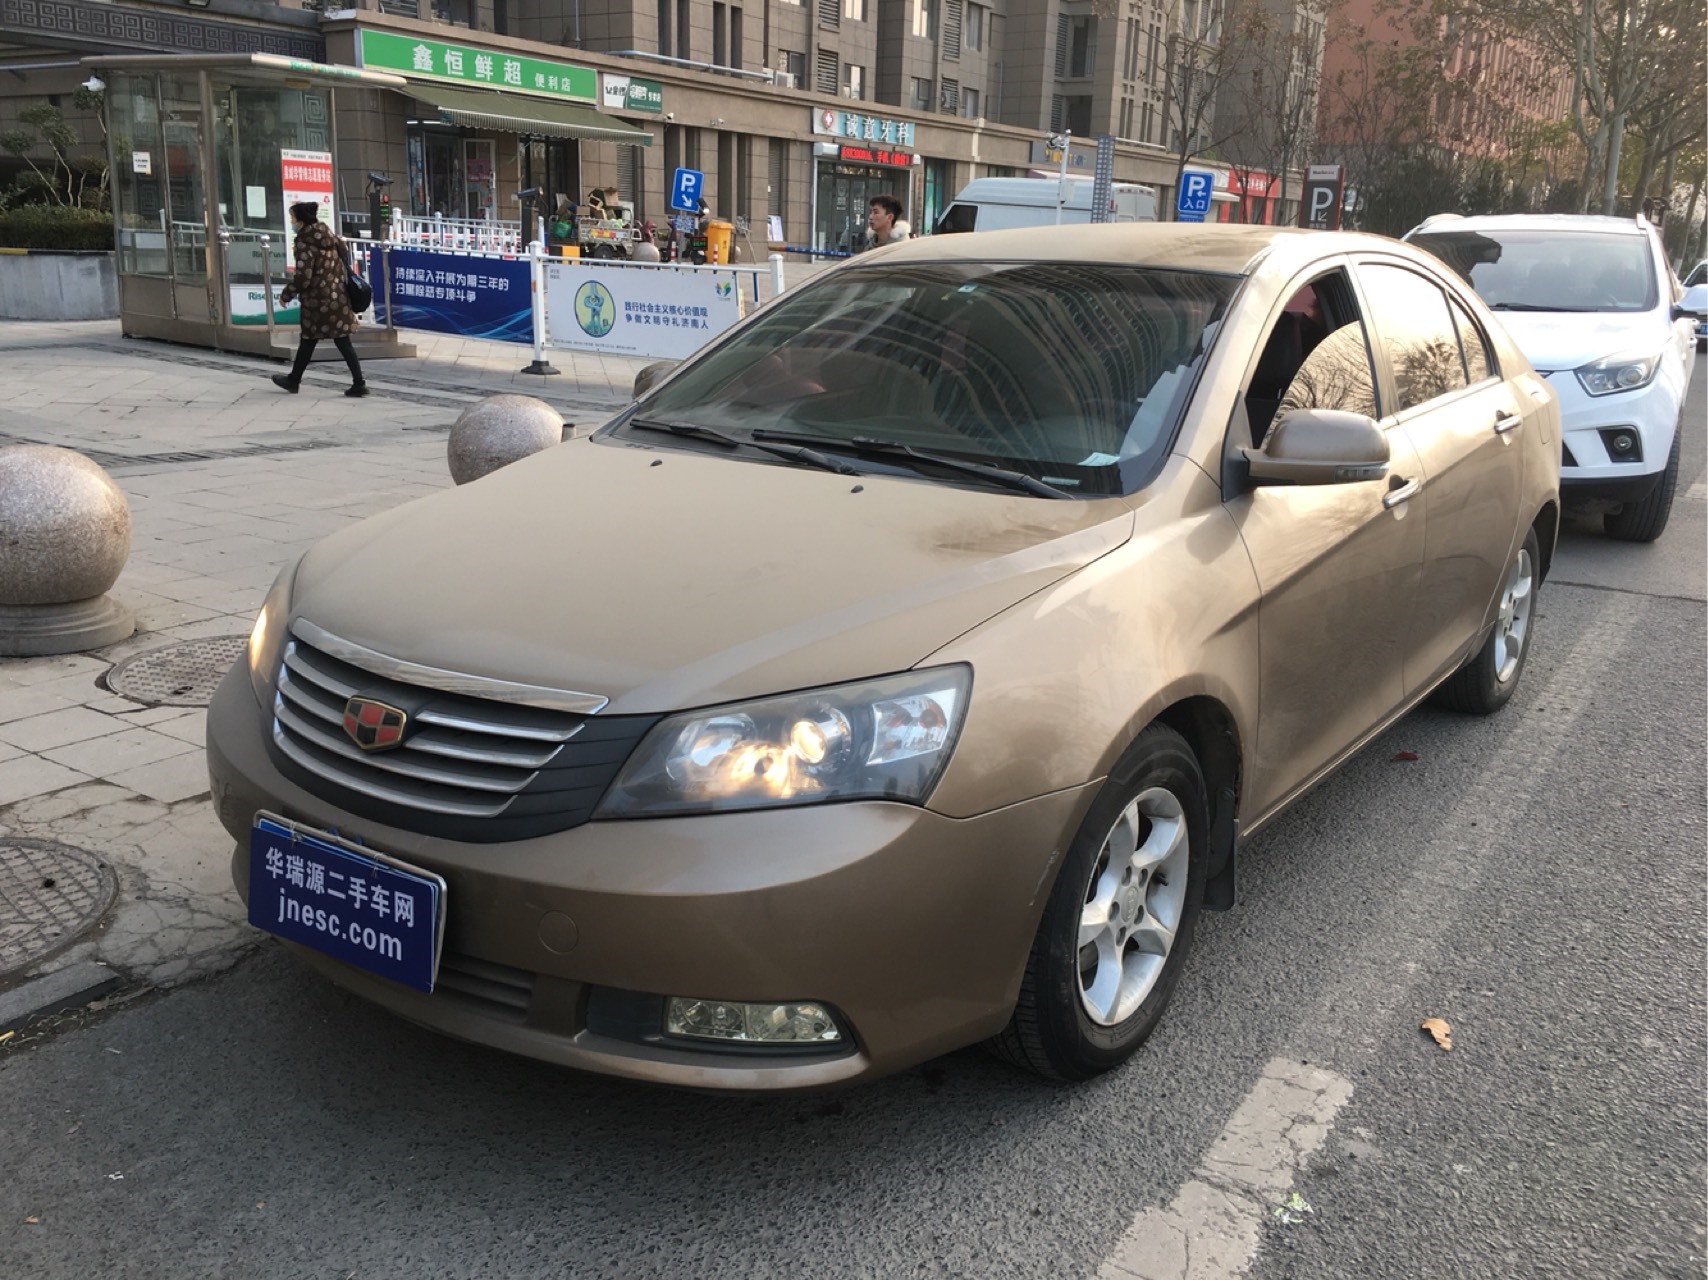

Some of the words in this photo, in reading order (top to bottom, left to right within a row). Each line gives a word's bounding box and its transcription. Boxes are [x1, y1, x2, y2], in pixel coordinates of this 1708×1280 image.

[412, 43, 522, 86] 鑫恒鲜超
[534, 72, 571, 92] 便利店
[681, 173, 696, 192] P
[1187, 176, 1206, 197] P
[1183, 198, 1206, 210] 入口
[1310, 187, 1334, 221] P
[395, 267, 509, 291] 持续深入开展为期三年的
[395, 283, 476, 303] 扫黑除恶专项斗争
[624, 301, 708, 318] 践行社会主义核心价值观
[625, 313, 709, 330] 争做文明守礼济南人
[265, 846, 415, 928] 华瑞源二手车网
[278, 887, 403, 961] jnesc.com
